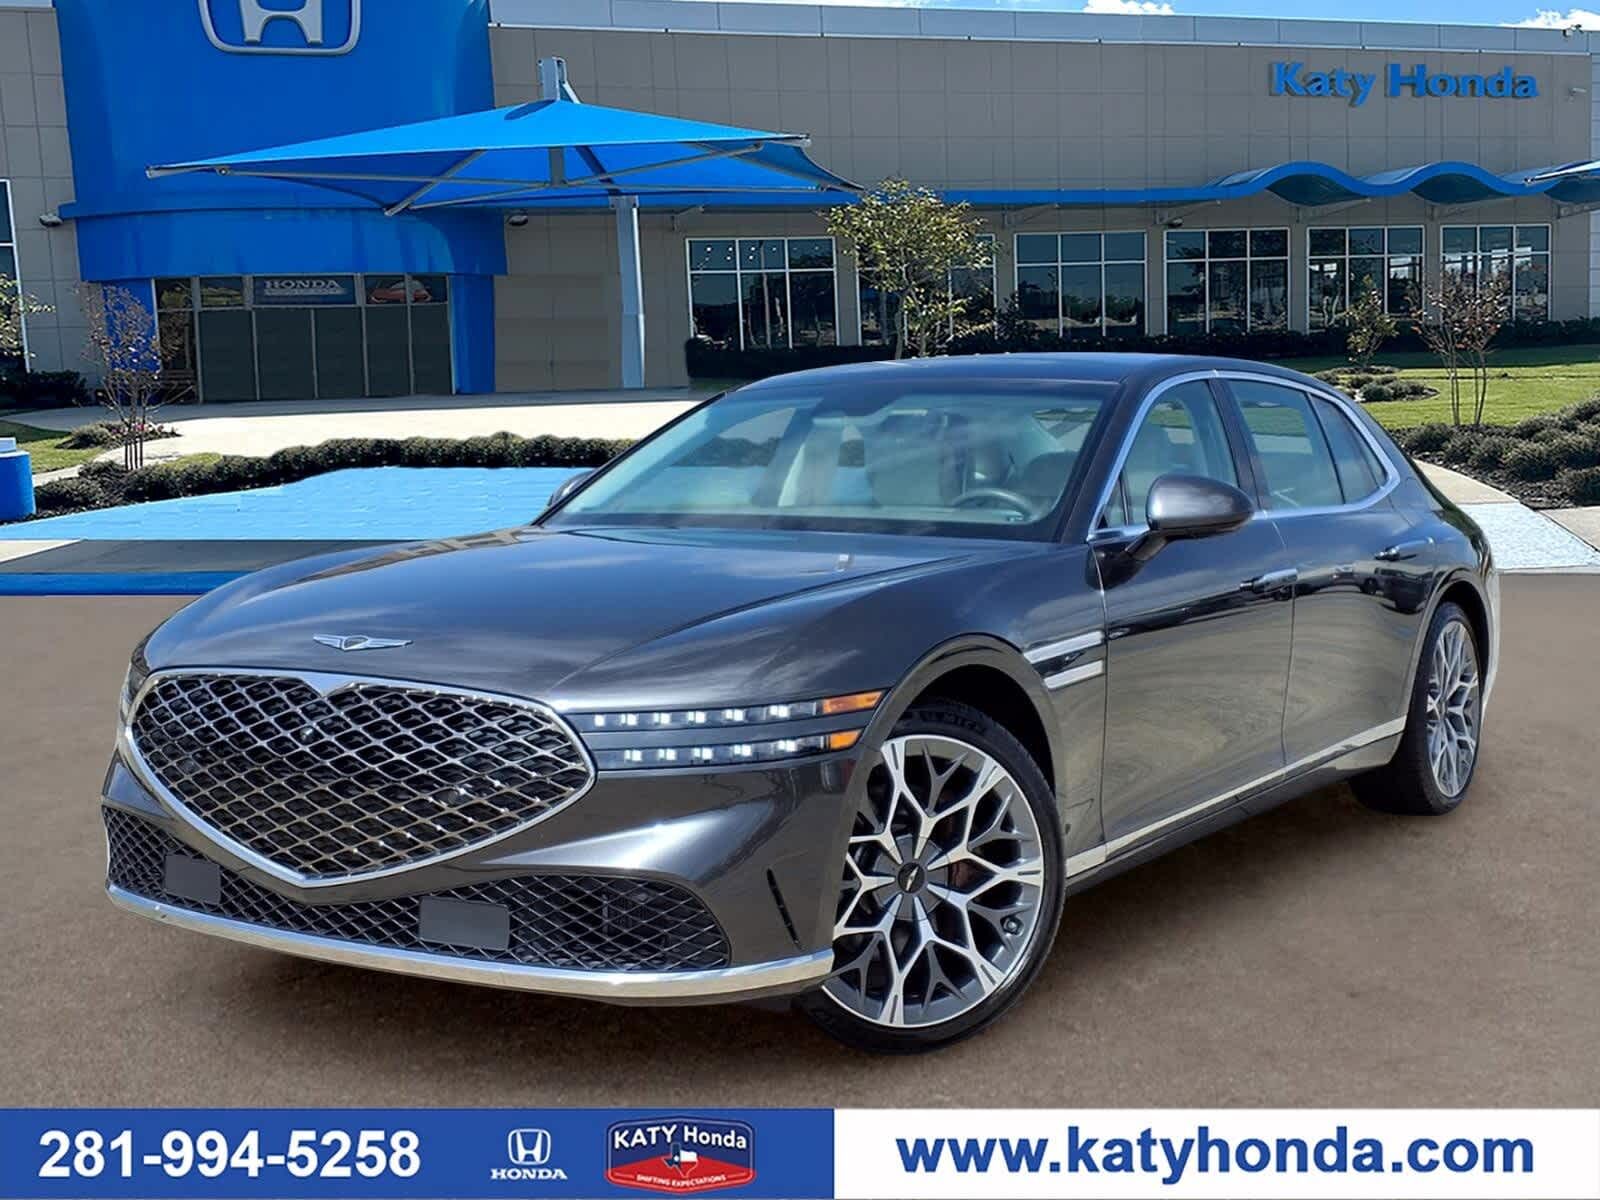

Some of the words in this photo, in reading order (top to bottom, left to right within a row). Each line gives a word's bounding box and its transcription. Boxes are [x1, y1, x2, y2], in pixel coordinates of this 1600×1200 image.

[1273, 63, 1376, 106] Katy
[1387, 63, 1539, 98] Honda
[264, 279, 340, 289] HONDA
